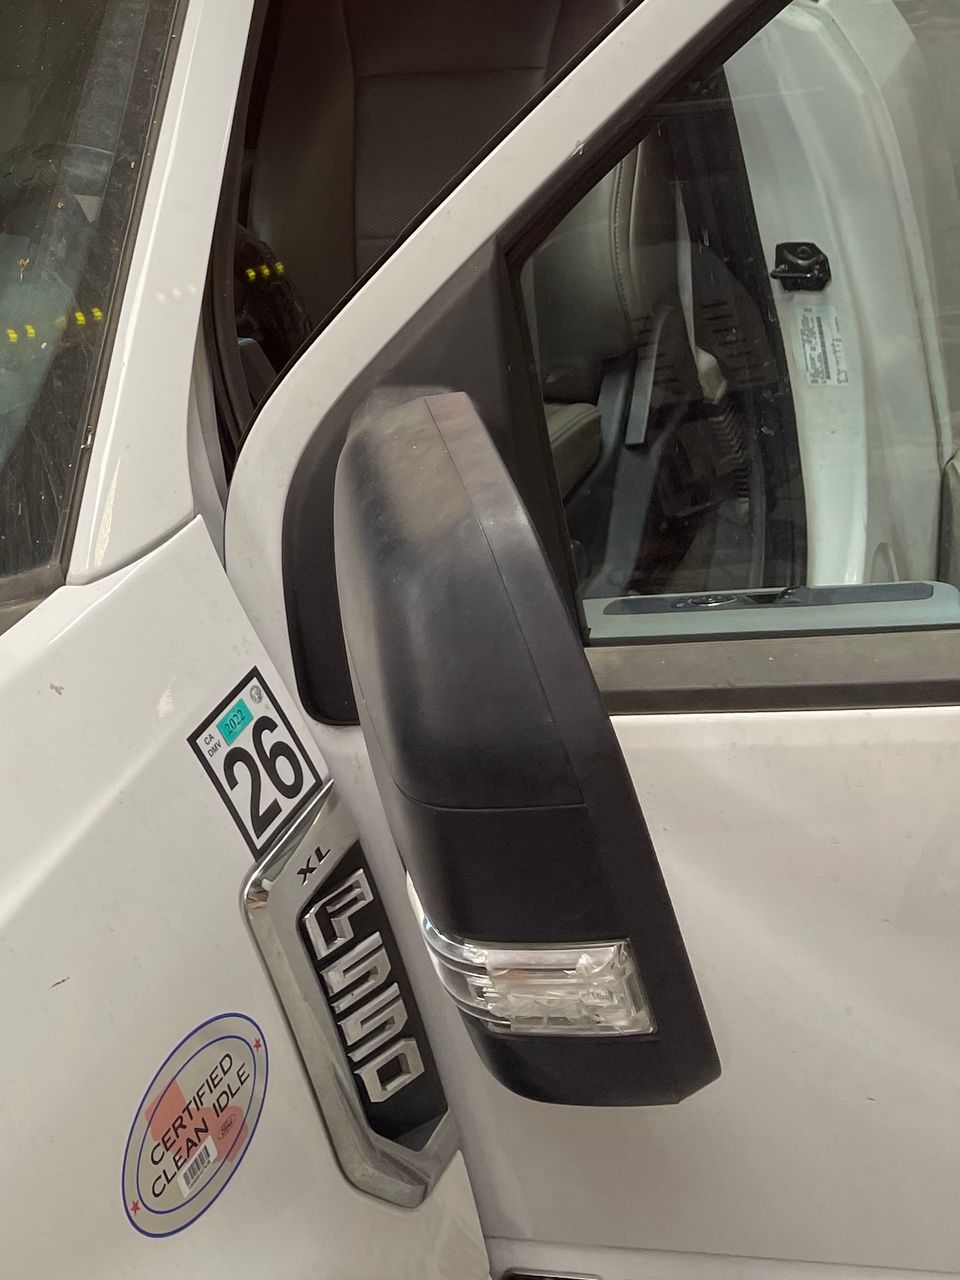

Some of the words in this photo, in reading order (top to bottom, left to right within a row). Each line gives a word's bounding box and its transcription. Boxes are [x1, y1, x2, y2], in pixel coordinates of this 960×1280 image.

[204, 733, 214, 745] CA
[207, 739, 221, 758] DMV
[224, 709, 246, 735] 2022
[223, 715, 304, 839] 26
[297, 845, 331, 886] XL
[303, 868, 425, 1103] F550
[150, 1053, 233, 1166] CERTIFIED
[151, 1117, 209, 1198] CLEAN
[212, 1062, 251, 1118] IDLE
